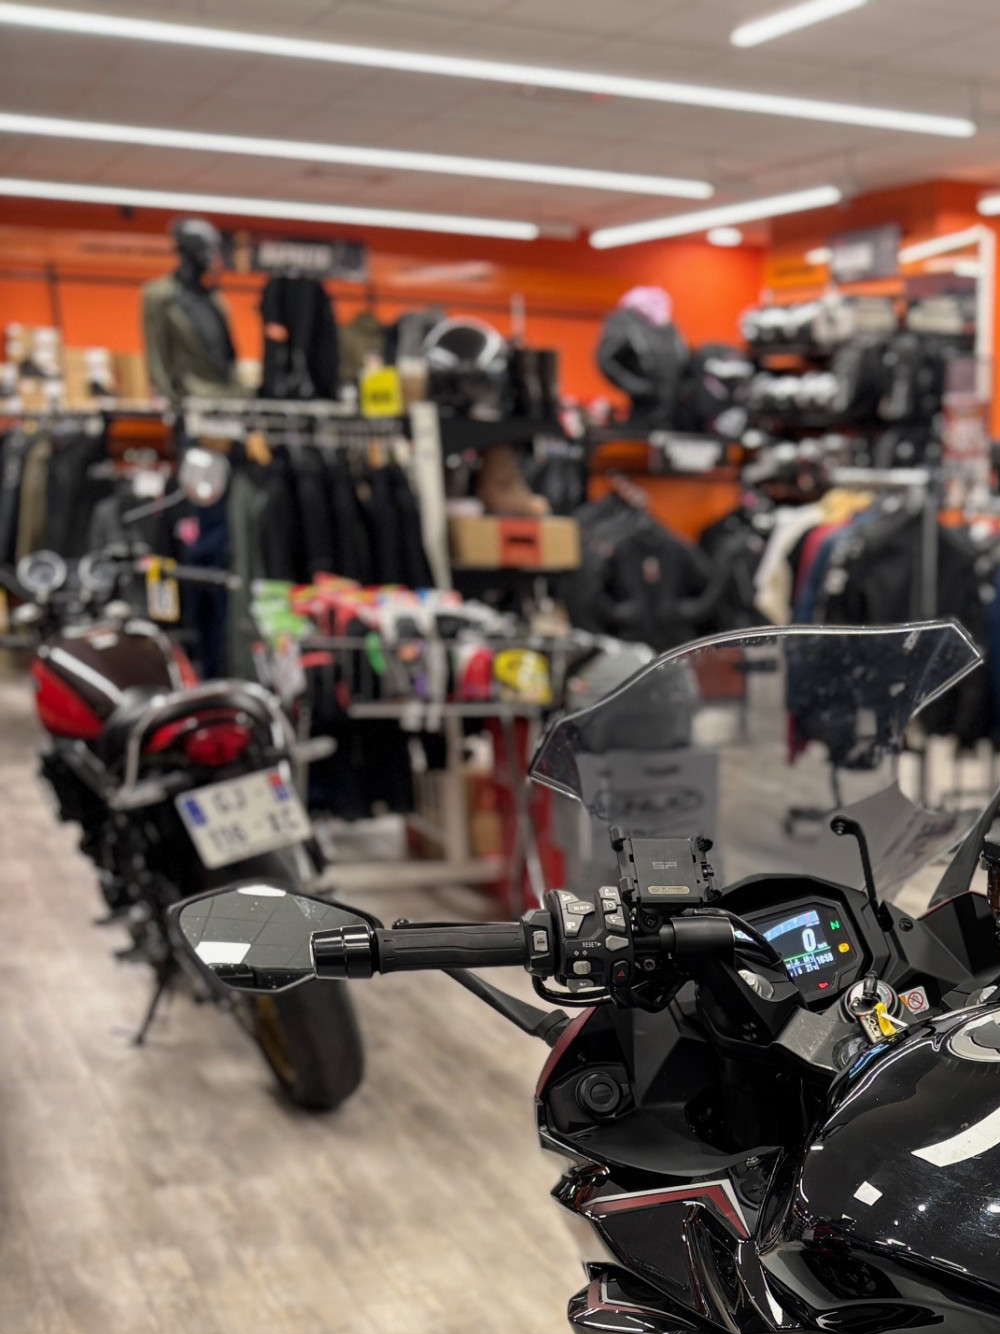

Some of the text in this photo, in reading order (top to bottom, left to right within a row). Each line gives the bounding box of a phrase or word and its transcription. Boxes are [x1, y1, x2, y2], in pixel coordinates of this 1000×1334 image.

[652, 861, 677, 870] SP
[830, 920, 840, 931] N
[802, 928, 816, 952] 0
